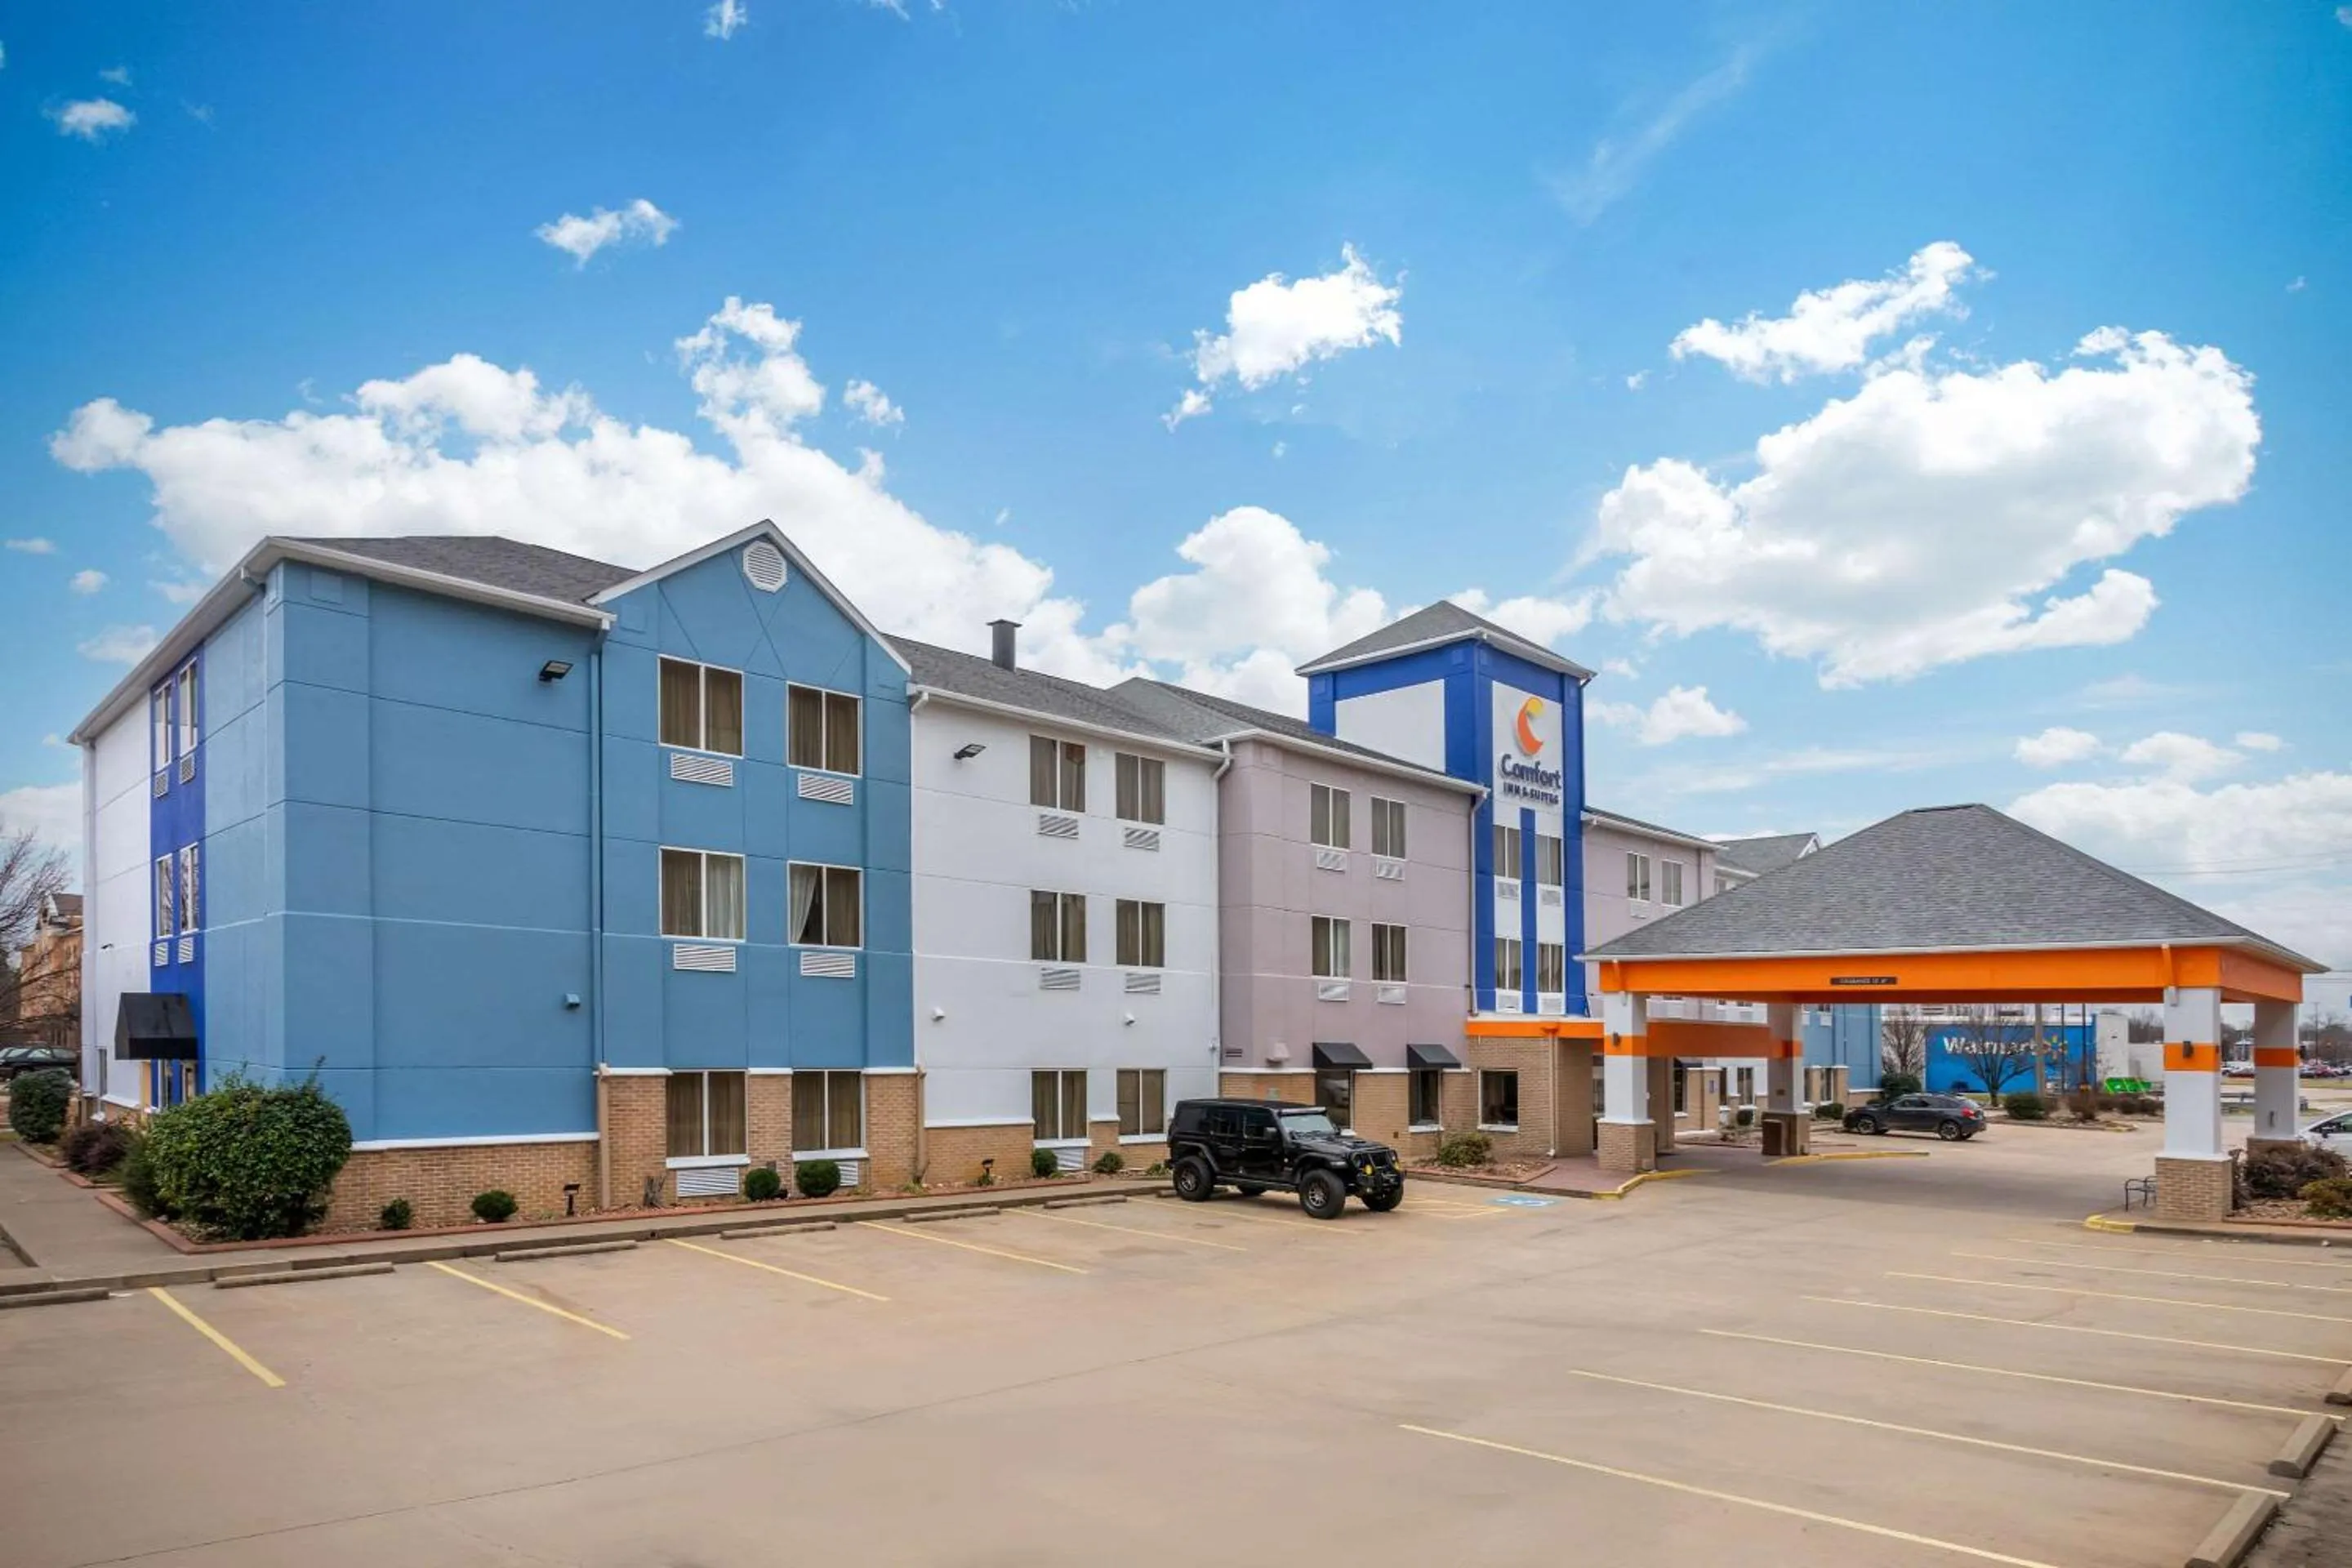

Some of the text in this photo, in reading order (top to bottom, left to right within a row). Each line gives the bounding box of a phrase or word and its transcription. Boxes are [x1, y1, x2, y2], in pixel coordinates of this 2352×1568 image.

[1501, 754, 1561, 789] Comfort
[1503, 782, 1559, 804] INN & SUITES
